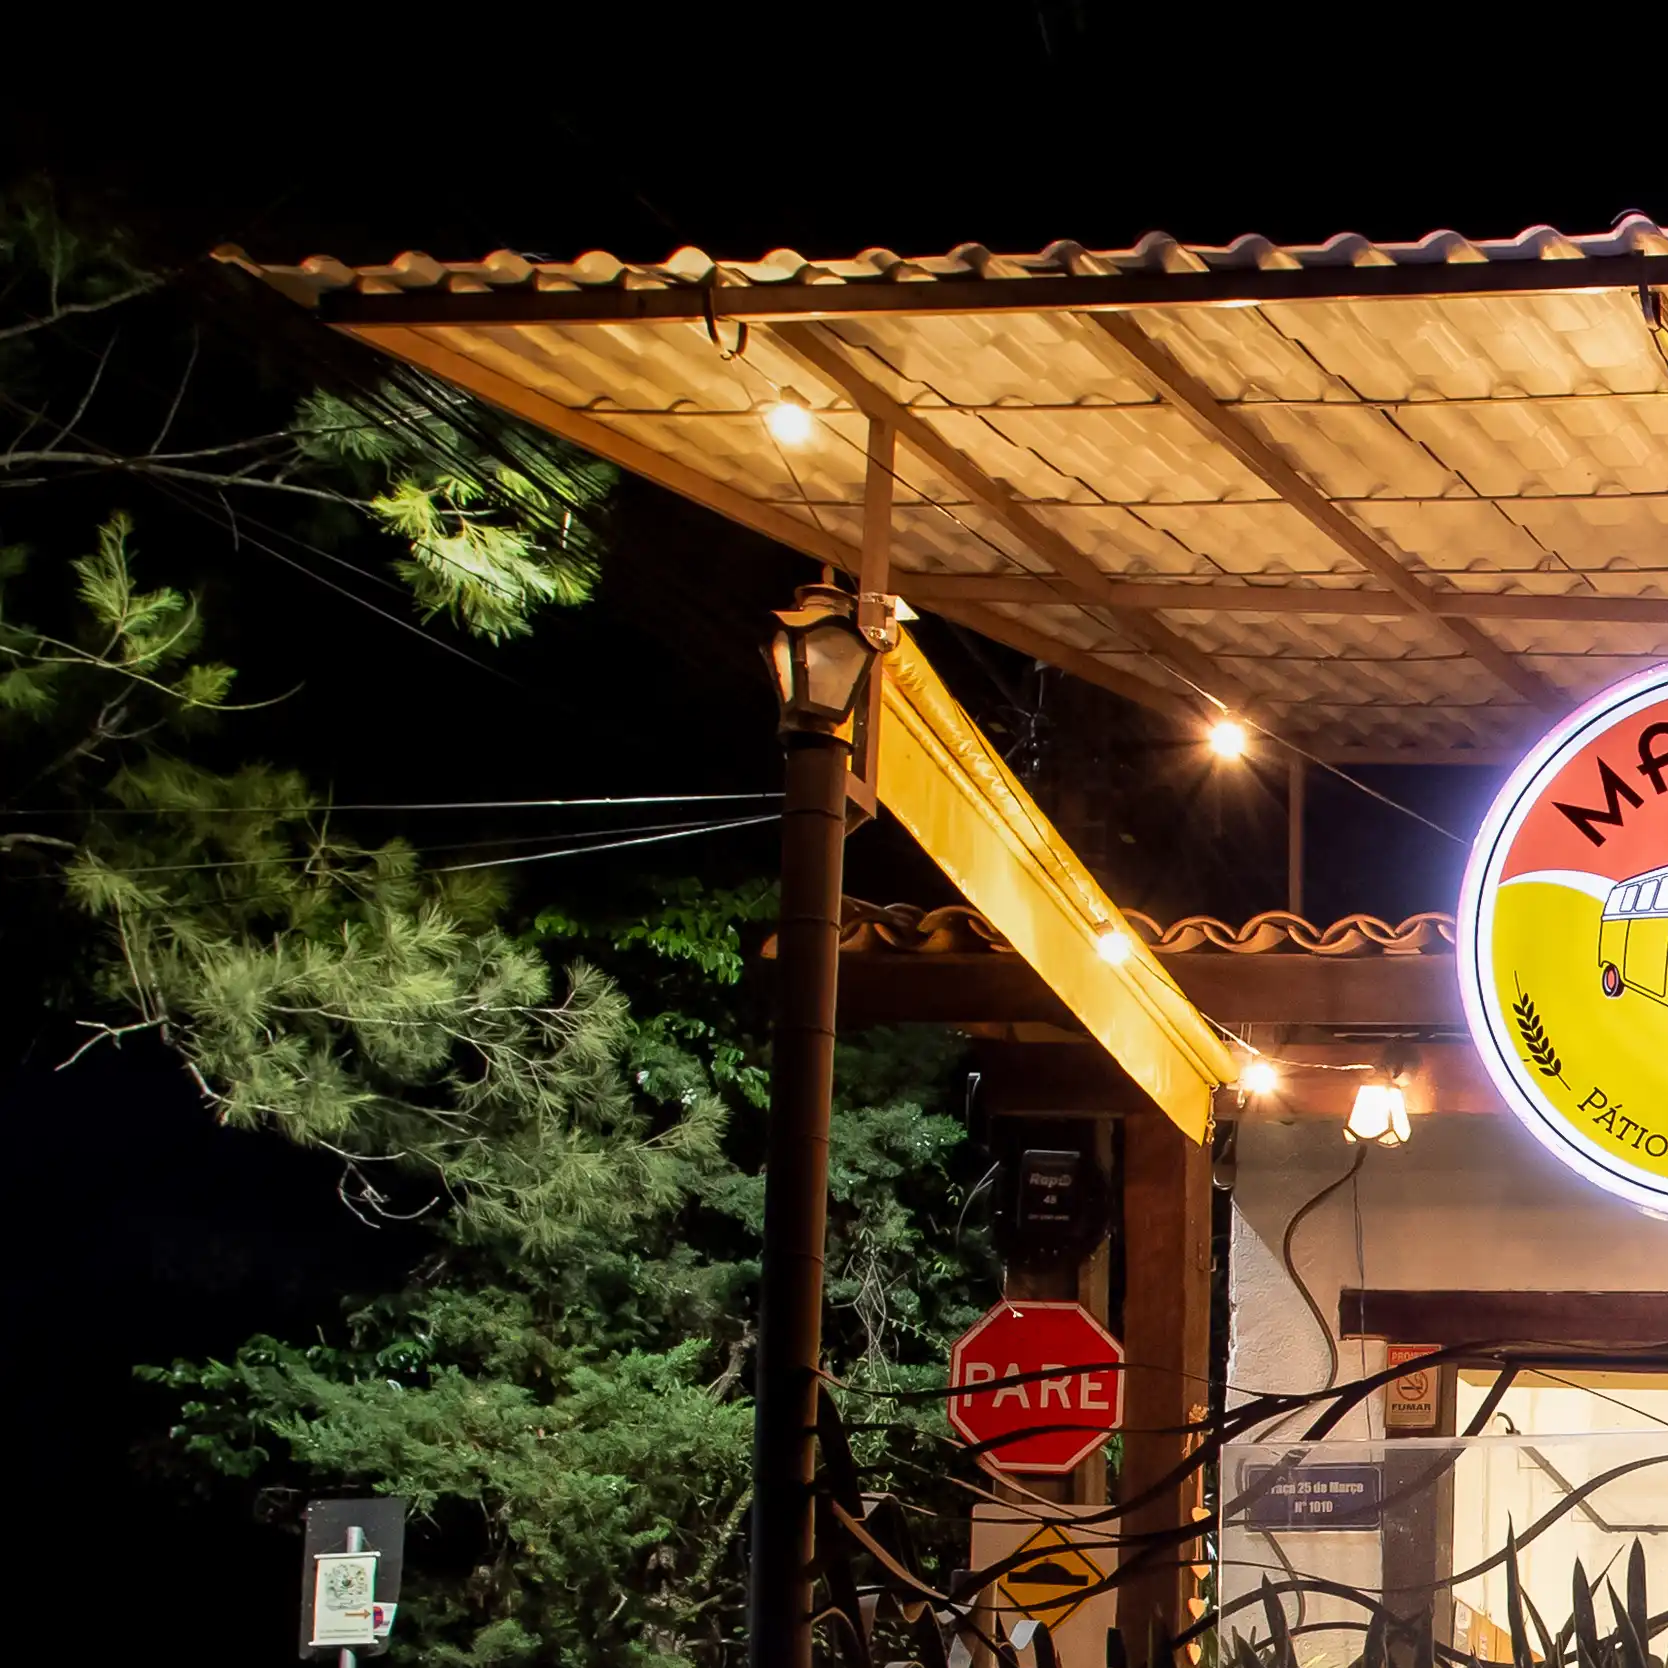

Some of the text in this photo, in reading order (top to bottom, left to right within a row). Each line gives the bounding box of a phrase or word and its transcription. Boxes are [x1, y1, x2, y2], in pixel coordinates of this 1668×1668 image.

[963, 1362, 1110, 1410] PARE
[1391, 1403, 1431, 1411] FUMAR
[1265, 1481, 1365, 1496] raça 25 de Março
[1309, 1501, 1333, 1513] 1010
